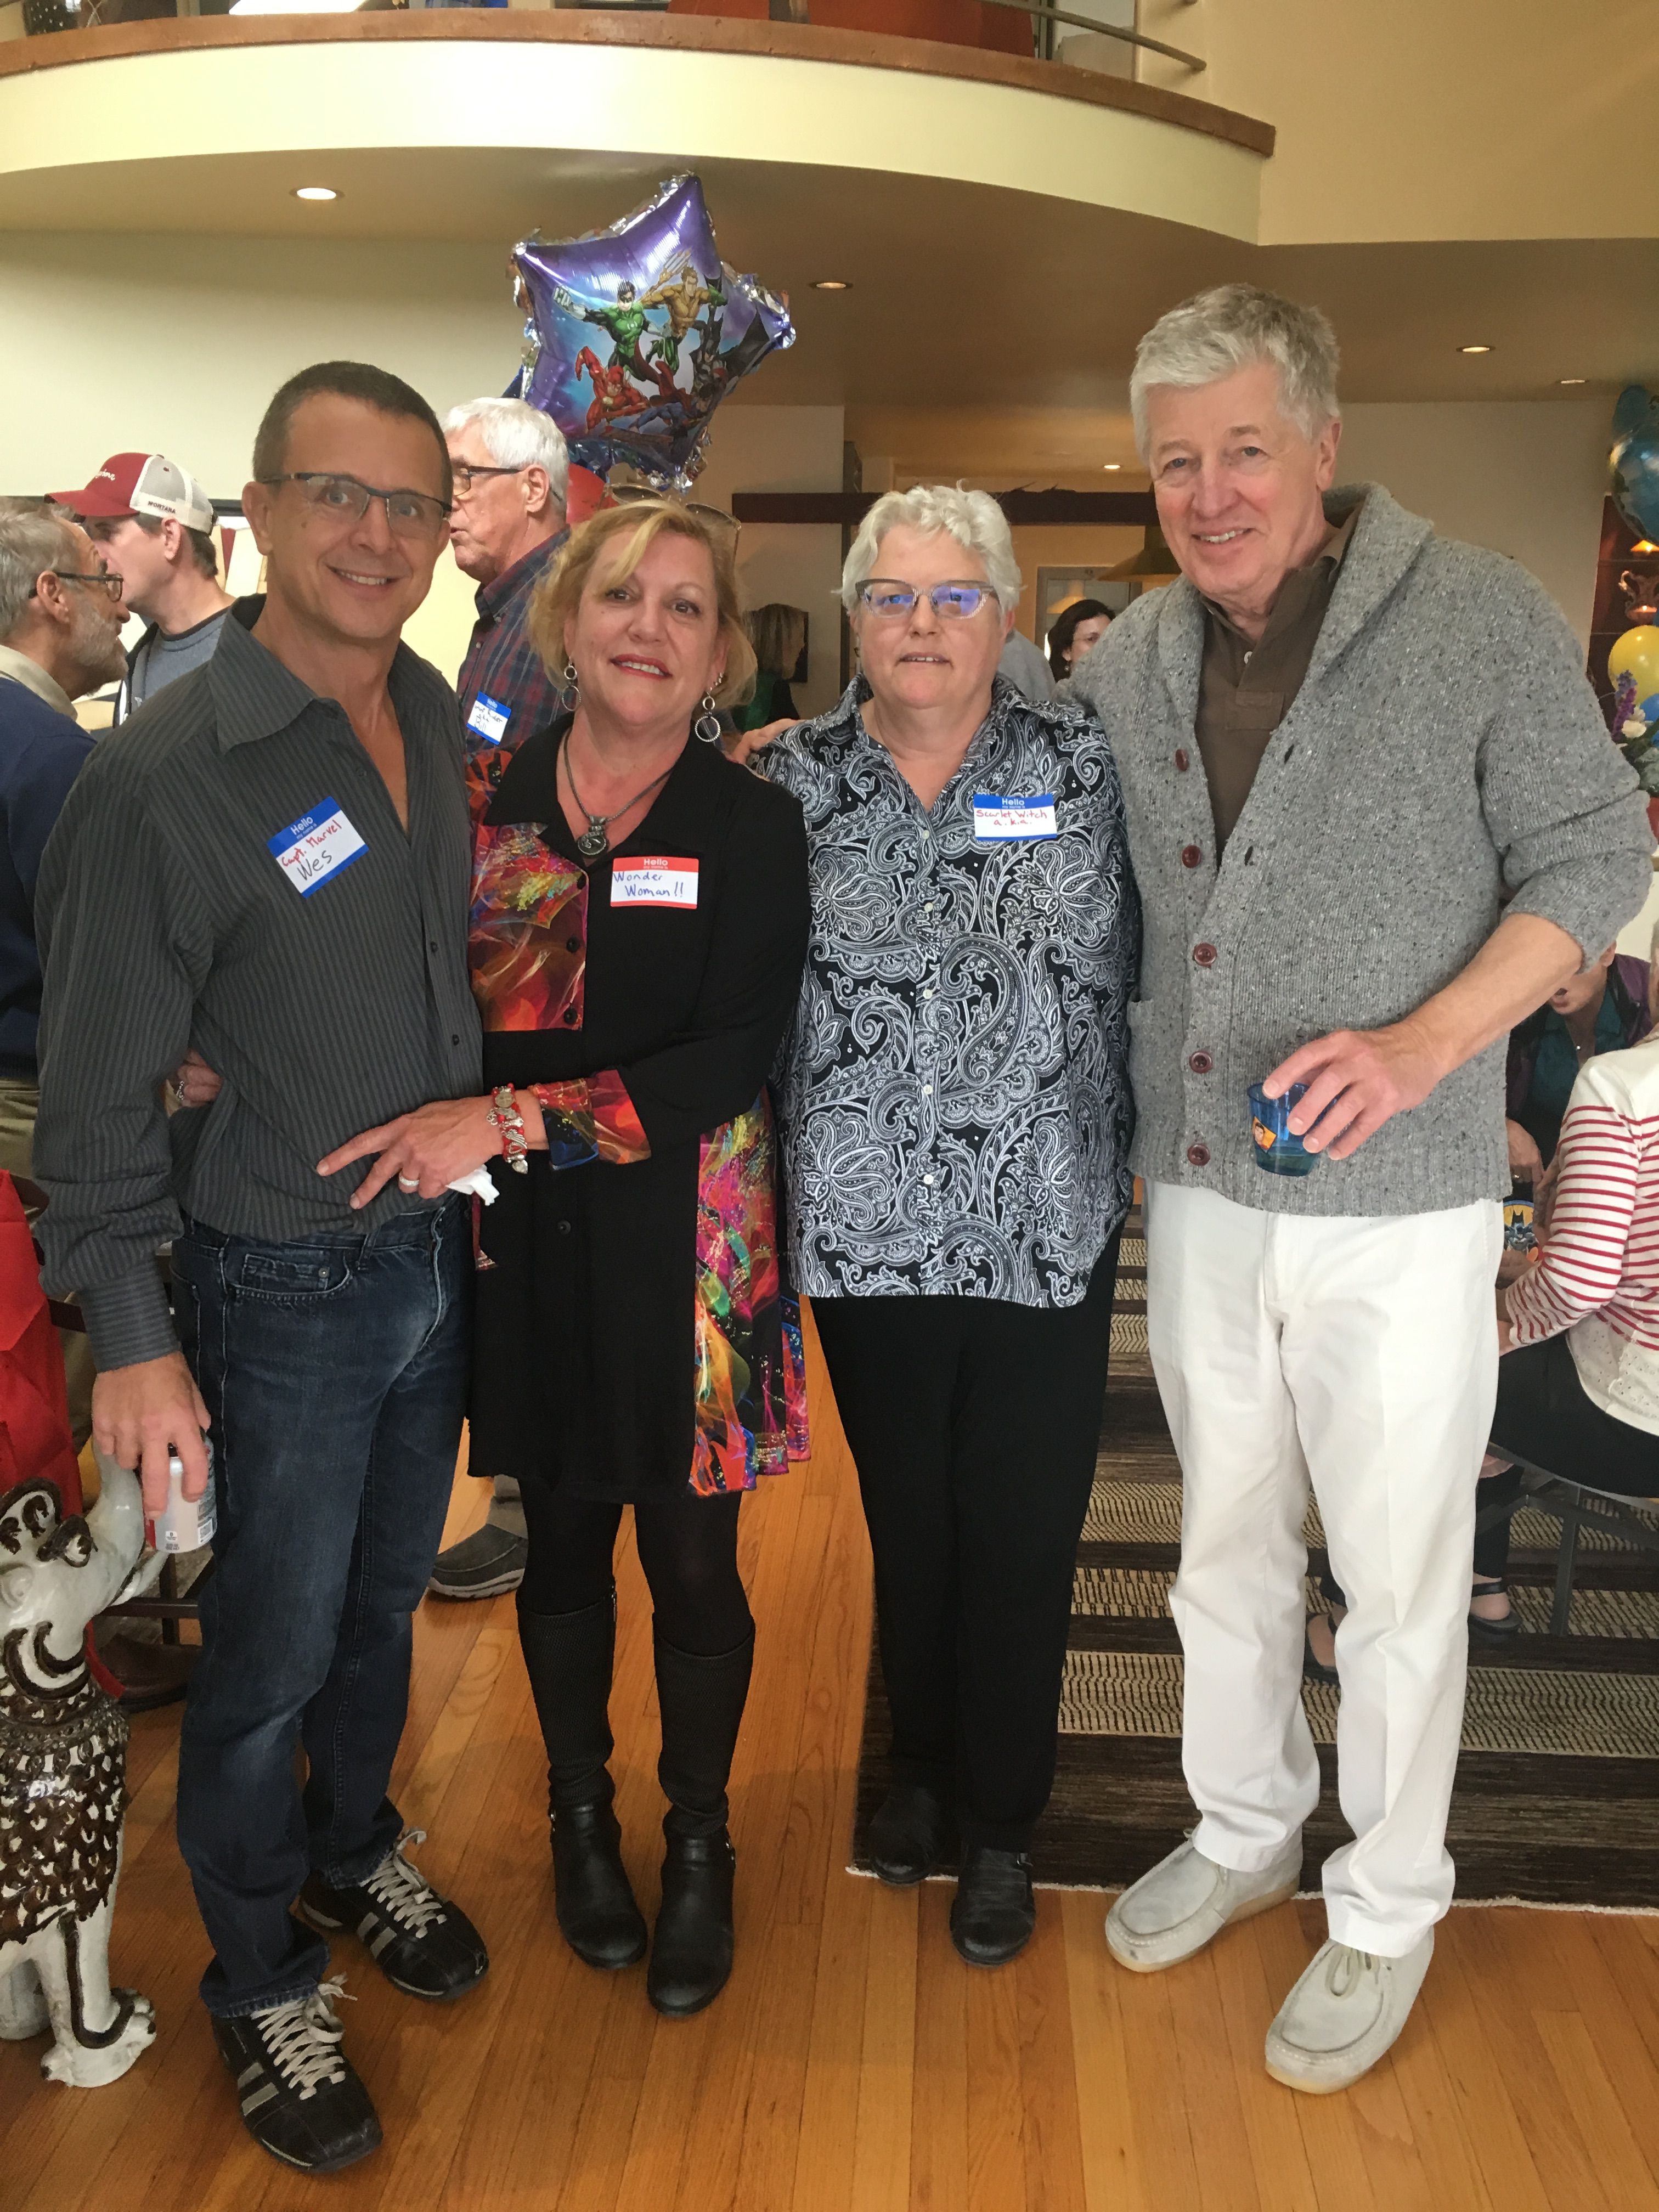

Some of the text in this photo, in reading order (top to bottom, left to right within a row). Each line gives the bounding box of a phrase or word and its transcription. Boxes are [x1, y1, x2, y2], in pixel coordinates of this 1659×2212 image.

[148, 501, 176, 514] MONTANA
[976, 809, 1047, 819] Scarlet Witch
[290, 816, 313, 835] Hello
[306, 820, 342, 848] Marvel
[297, 850, 332, 881] Wes
[644, 858, 668, 866] Hello
[613, 872, 663, 883] Wonder
